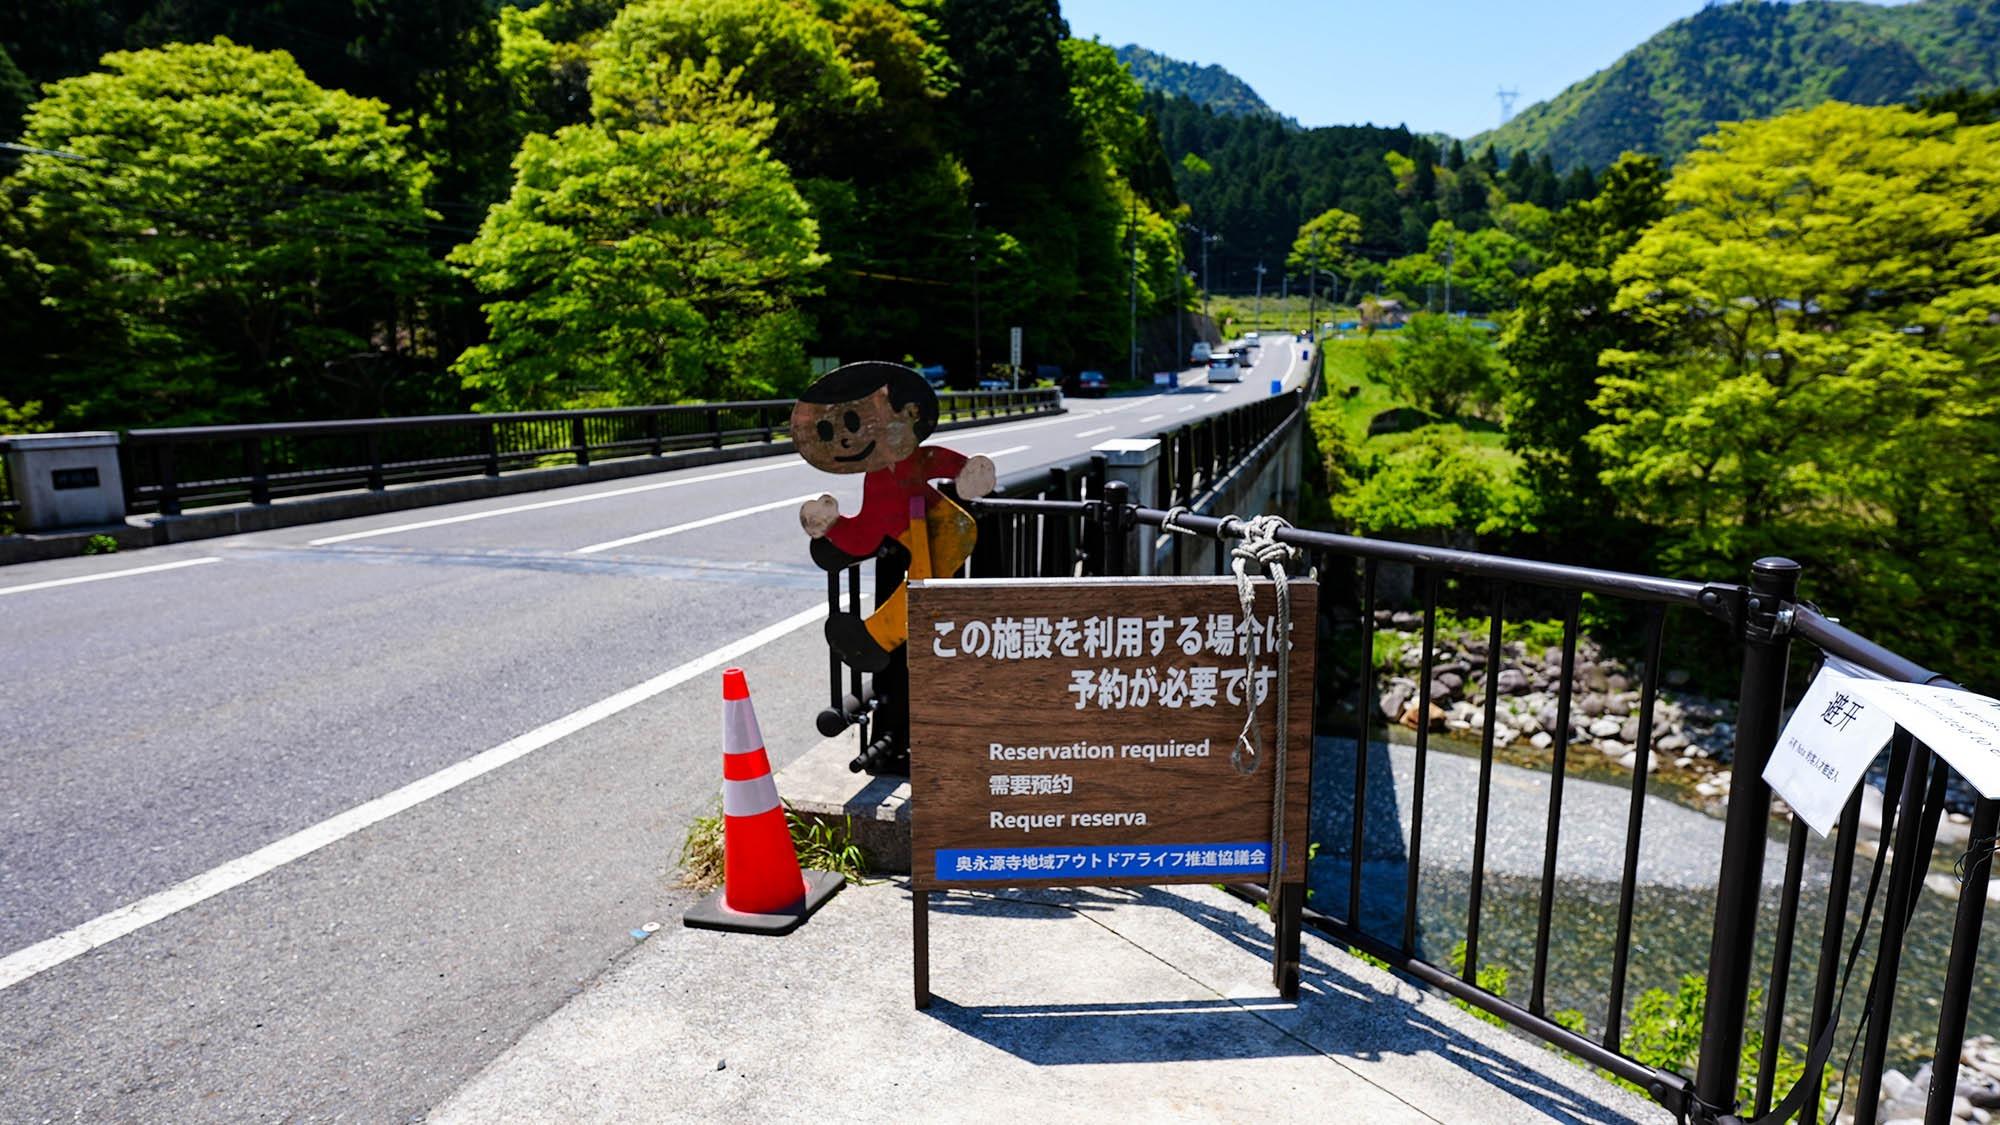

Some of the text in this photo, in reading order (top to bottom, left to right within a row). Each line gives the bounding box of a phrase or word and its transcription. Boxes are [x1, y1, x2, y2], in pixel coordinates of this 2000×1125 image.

[932, 614, 1294, 660] この施設を利用する場合は
[1068, 666, 1277, 711] 予約が必要です
[1820, 691, 1864, 733] 避开
[989, 738, 1210, 760] Reservation required
[989, 775, 1073, 796] 需要预约
[990, 811, 1146, 832] Requer reserva
[956, 849, 1266, 872] 奥永源寺地域アウトドアライフ推進協議会
